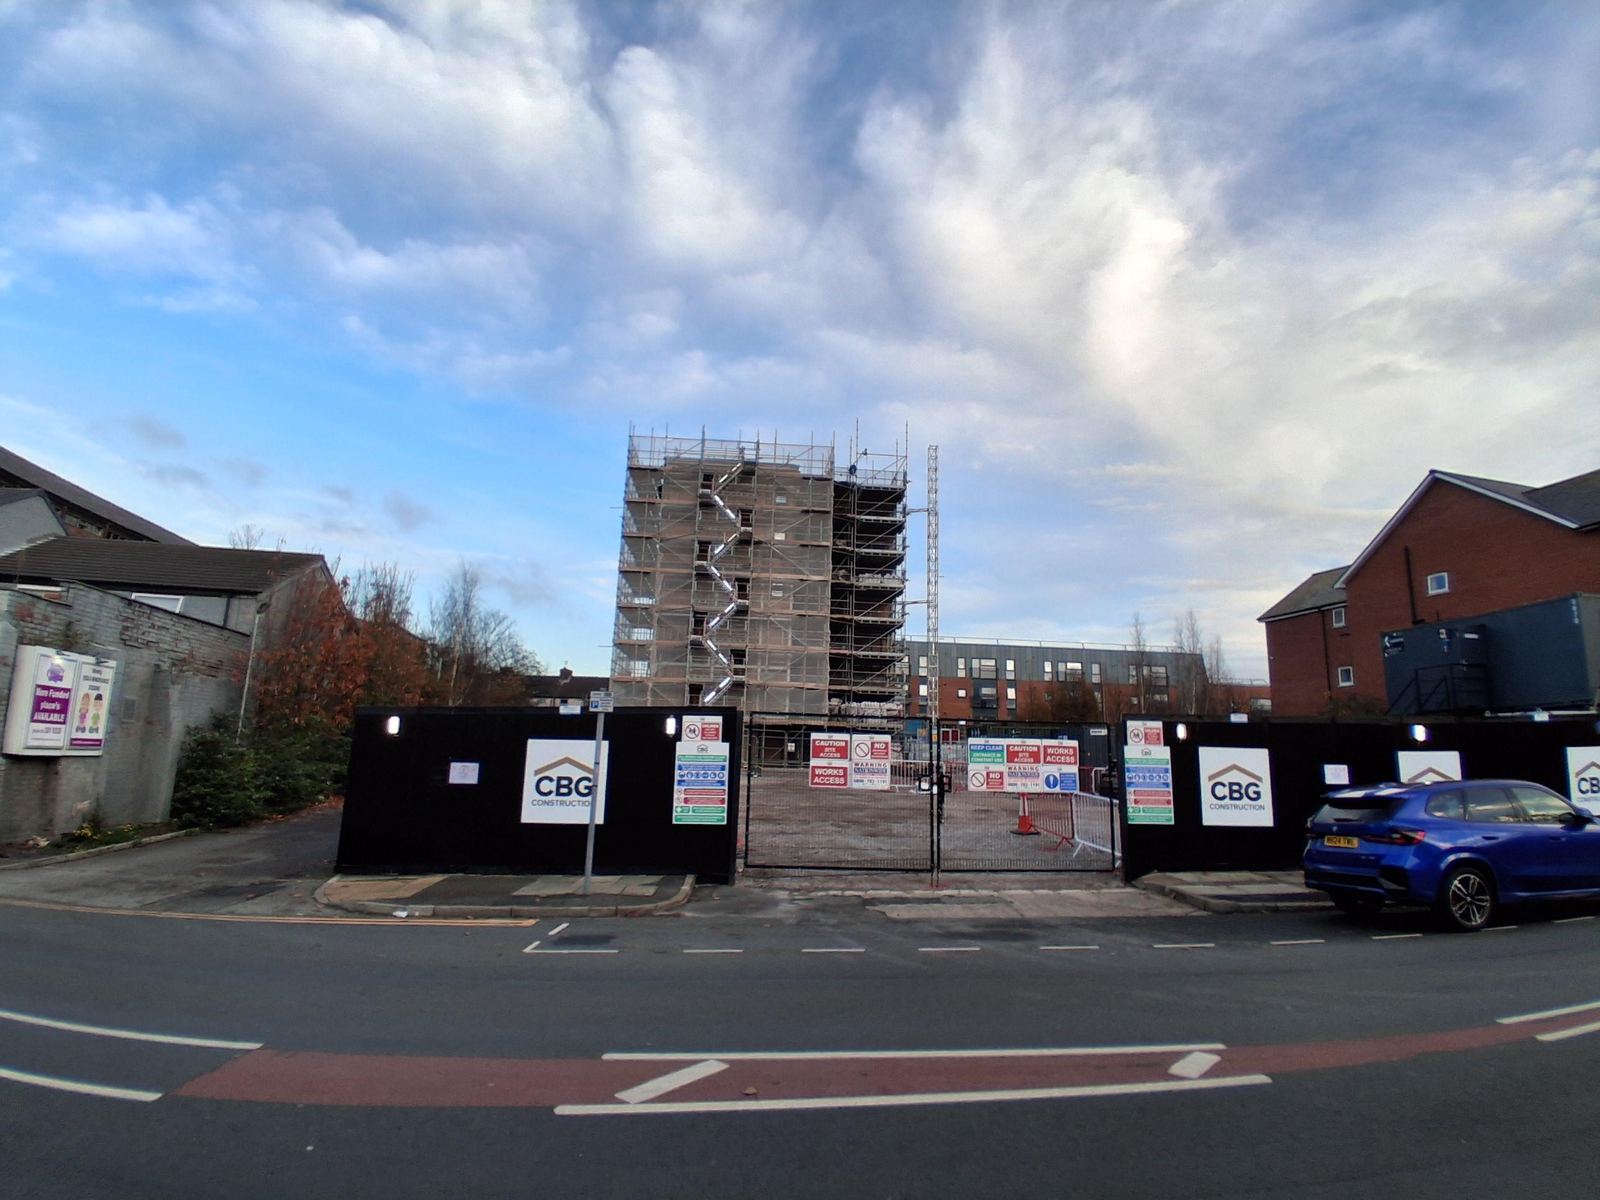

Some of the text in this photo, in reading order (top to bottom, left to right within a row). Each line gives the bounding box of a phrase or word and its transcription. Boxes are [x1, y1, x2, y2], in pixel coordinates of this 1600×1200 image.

[48, 689, 70, 699] Funded
[33, 712, 65, 722] AVAILABLE
[1045, 755, 1075, 763] ACCESS
[814, 768, 844, 776] WORKS
[535, 776, 593, 798] CBG
[1578, 777, 1600, 794] CB
[1210, 781, 1261, 802] CBG
[531, 799, 591, 808] CONSTRUCTIO
[1209, 803, 1265, 811] CONSTRUCTION
